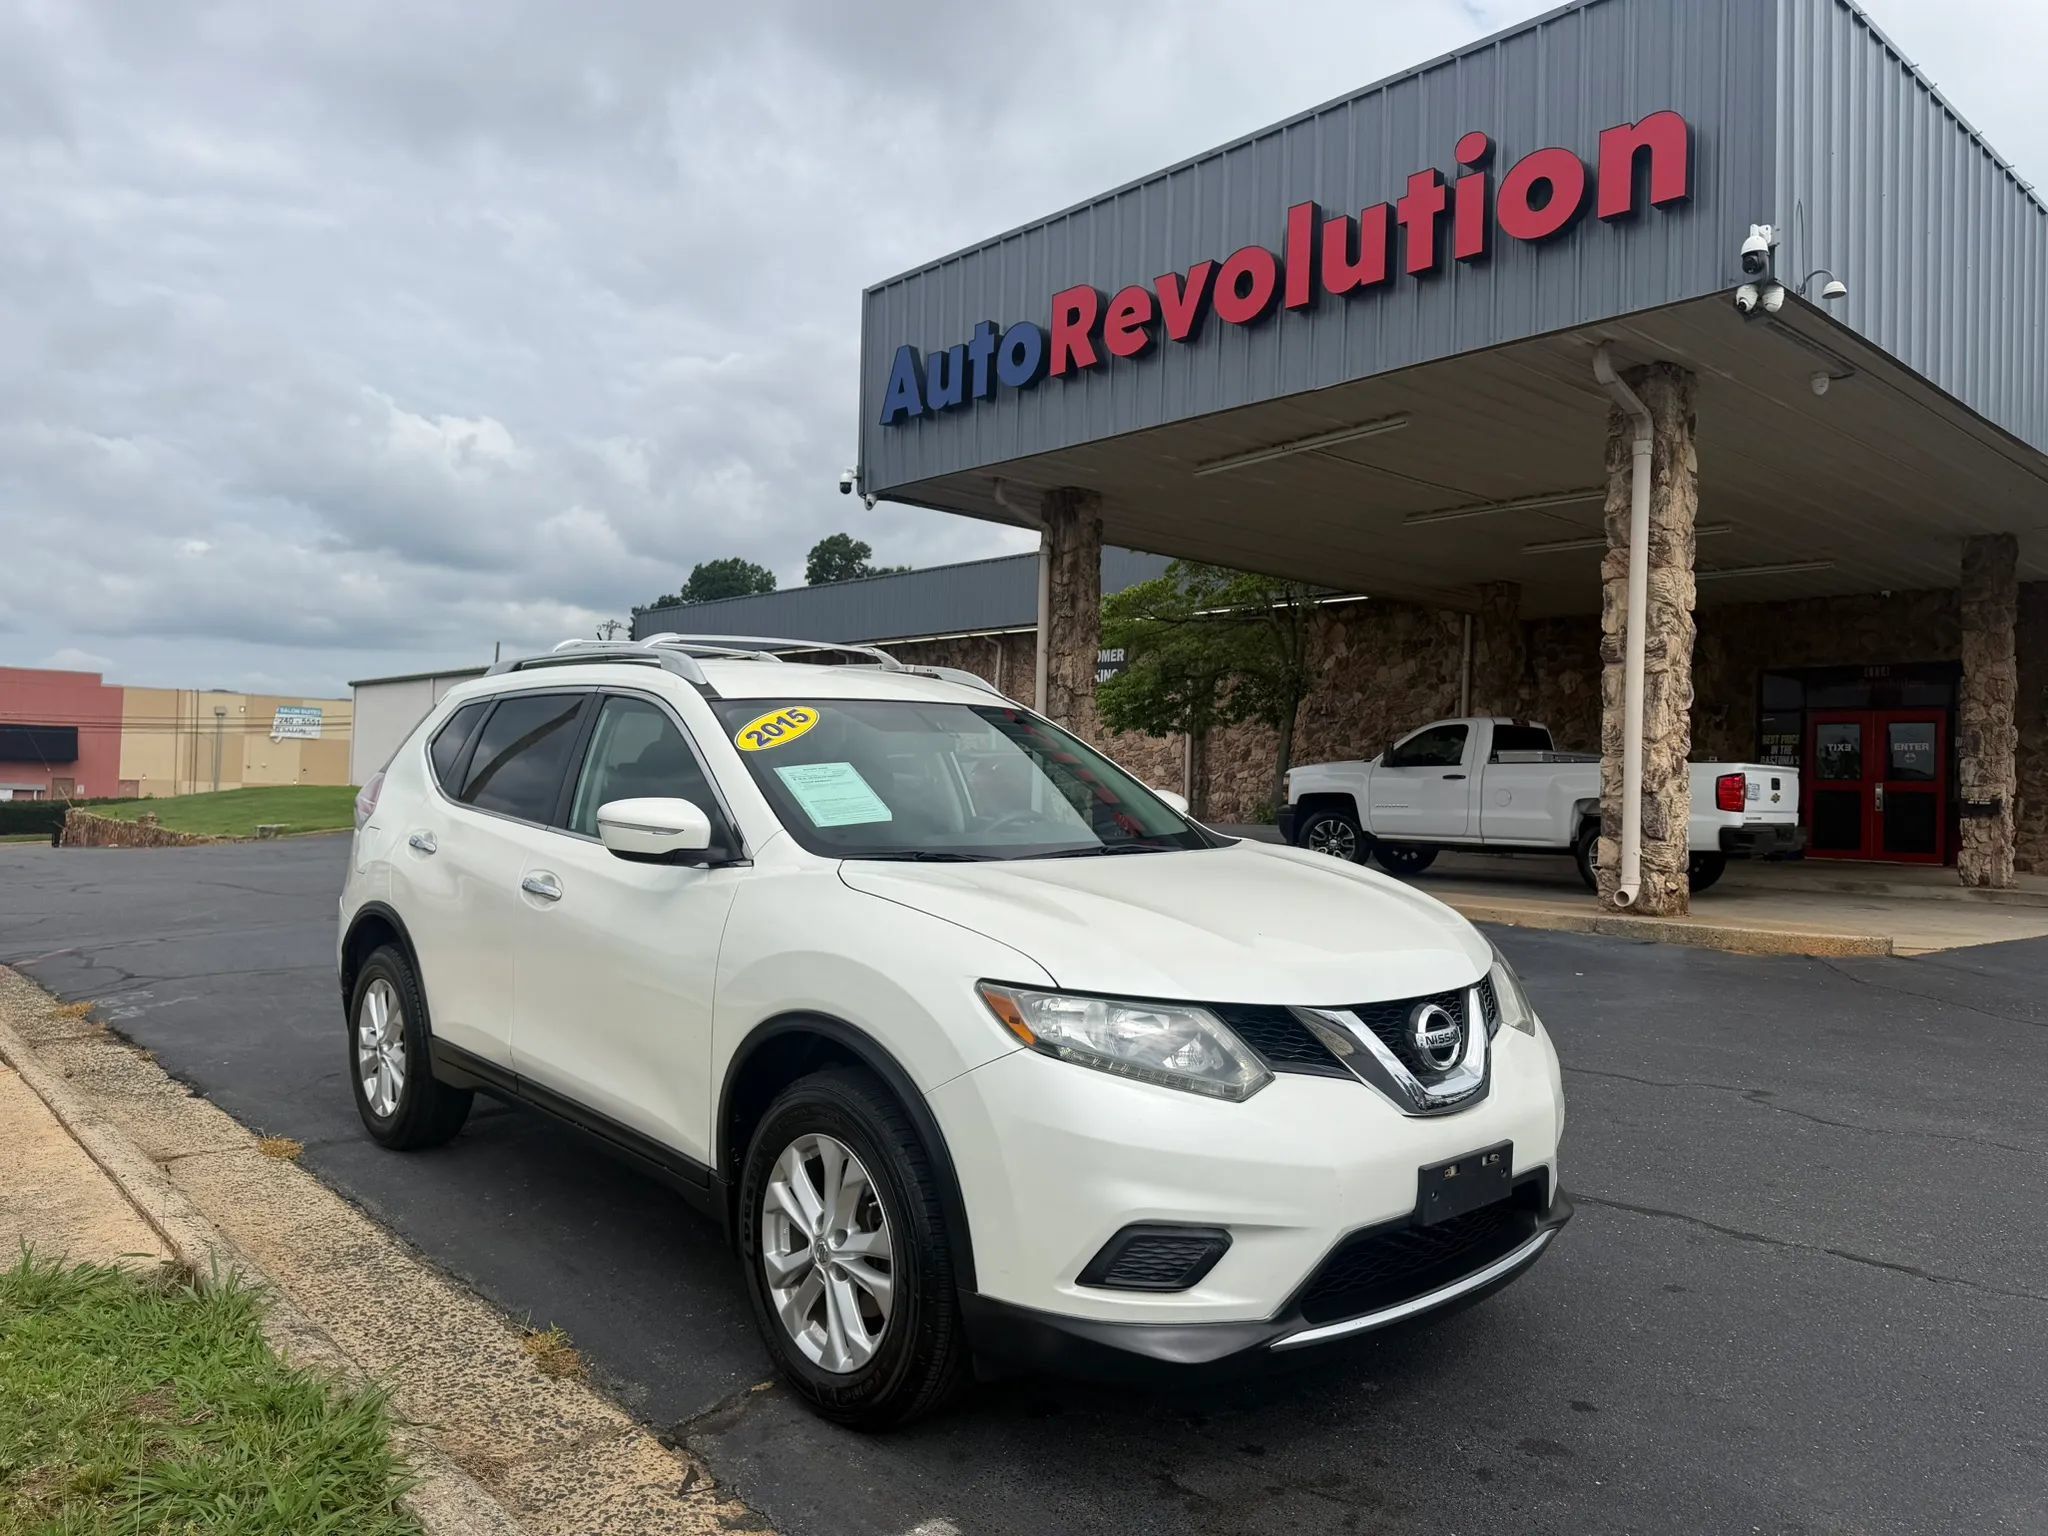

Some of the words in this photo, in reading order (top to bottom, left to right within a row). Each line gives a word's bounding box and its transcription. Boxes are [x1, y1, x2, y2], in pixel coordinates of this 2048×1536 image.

[745, 708, 810, 748] 2015
[1894, 743, 1929, 751] ENTER
[1424, 1026, 1459, 1045] NISSAN
